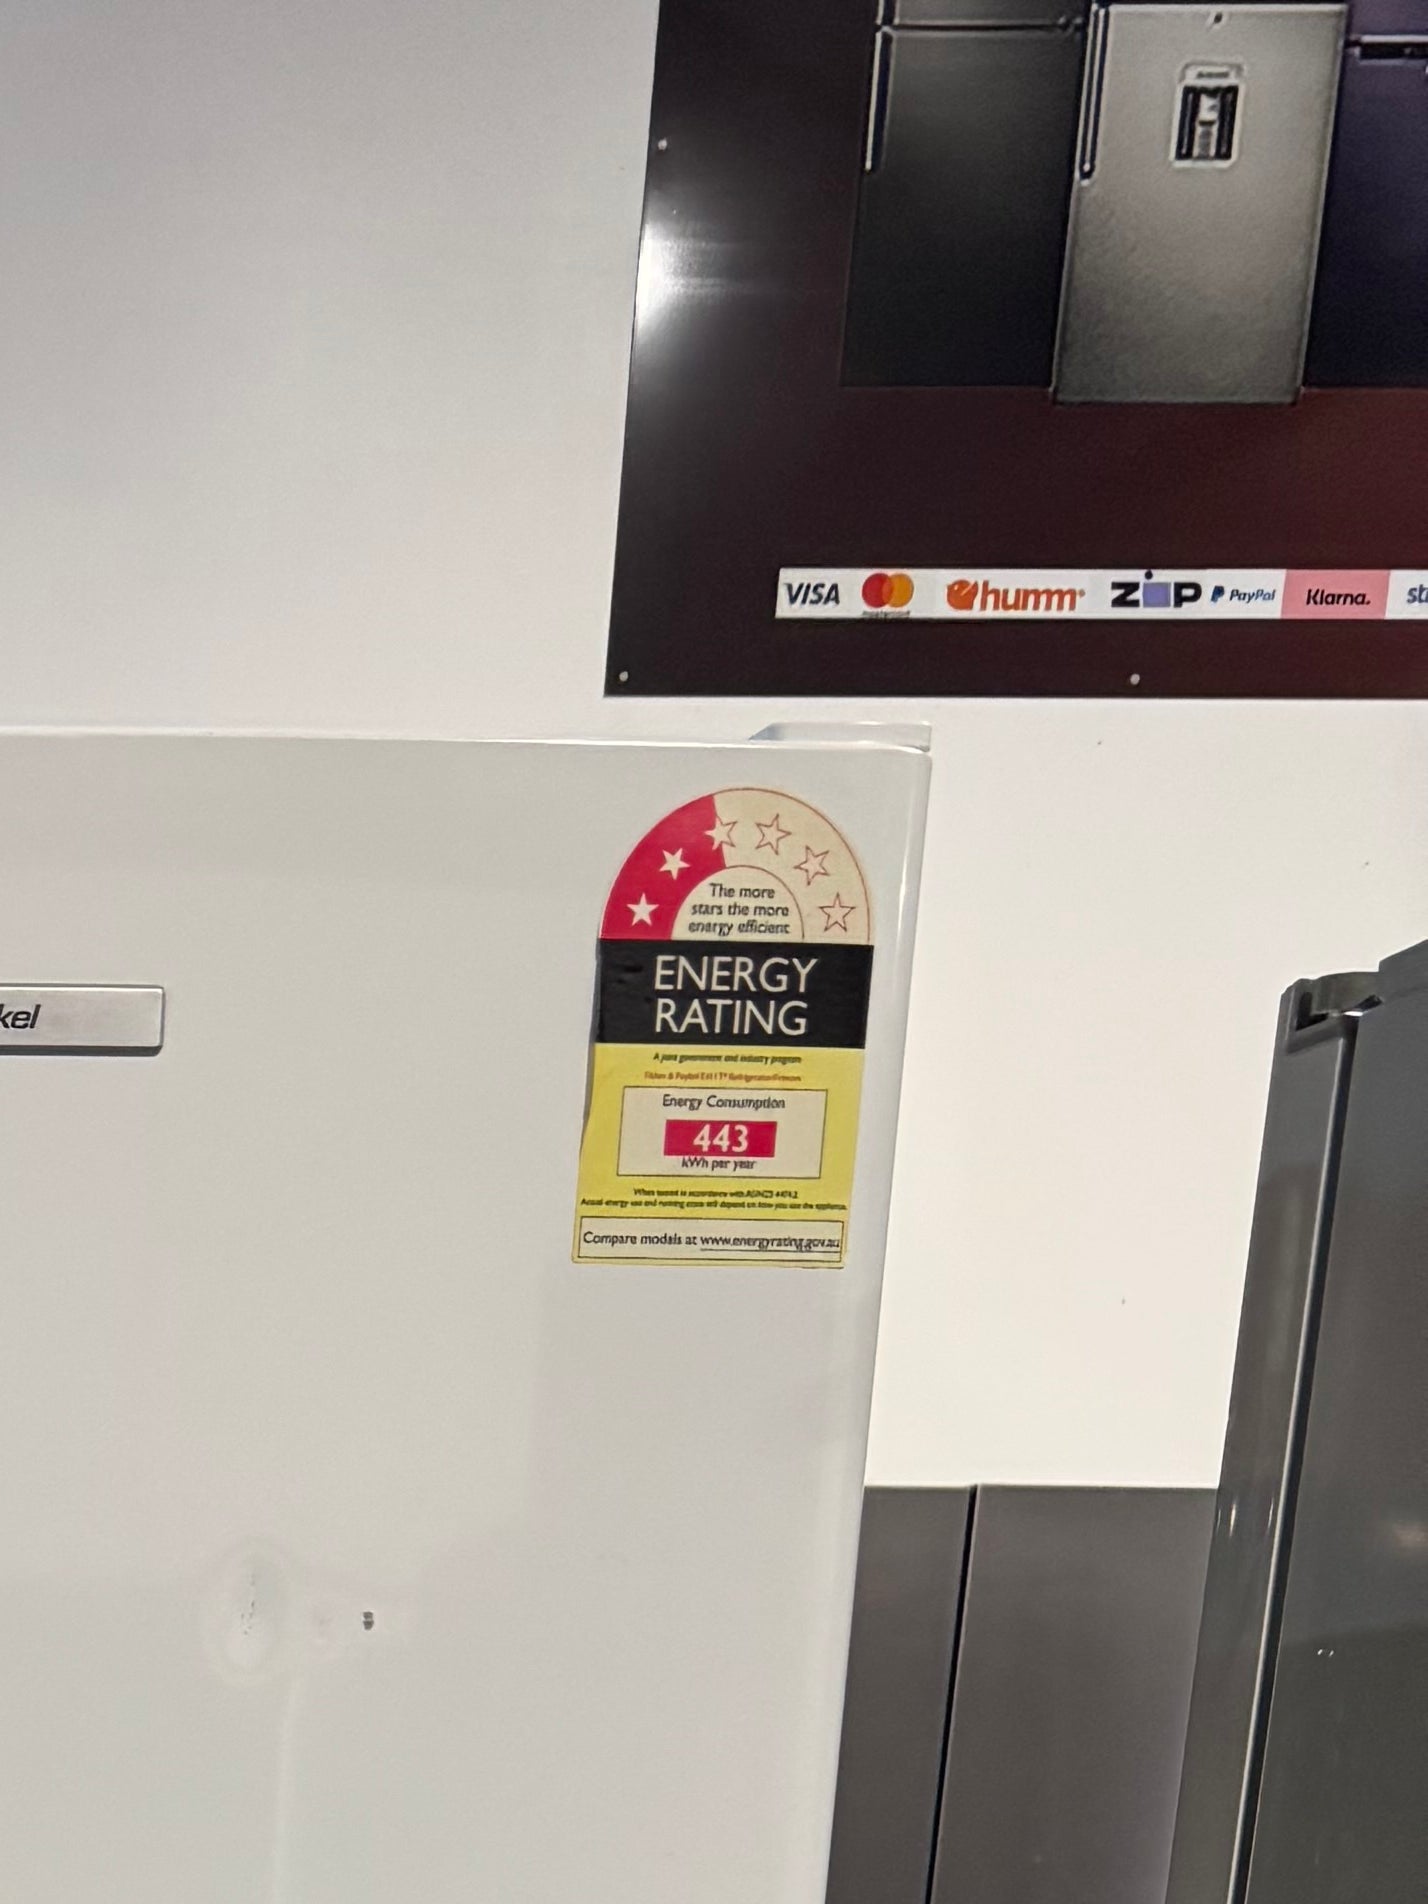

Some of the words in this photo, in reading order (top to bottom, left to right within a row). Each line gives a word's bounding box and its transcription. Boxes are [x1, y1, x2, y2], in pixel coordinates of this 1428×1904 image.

[784, 582, 841, 605] VISA
[980, 580, 1078, 611] humm
[1229, 588, 1276, 604] PayPal
[709, 882, 736, 898] The
[739, 887, 776, 899] more
[691, 903, 723, 916] stars
[727, 902, 750, 916] the
[753, 905, 790, 917] more
[687, 921, 734, 937] energy
[737, 919, 791, 934] efficient
[652, 954, 820, 994] ENERGY
[654, 998, 809, 1037] RATING
[662, 1093, 703, 1110] Energy
[706, 1094, 786, 1110] Consumption
[692, 1124, 750, 1153] 443
[681, 1157, 709, 1169] kWh
[711, 1160, 730, 1172] per
[732, 1159, 757, 1173] year
[582, 1231, 638, 1247] Compare
[640, 1232, 683, 1246] models
[684, 1236, 698, 1246] at
